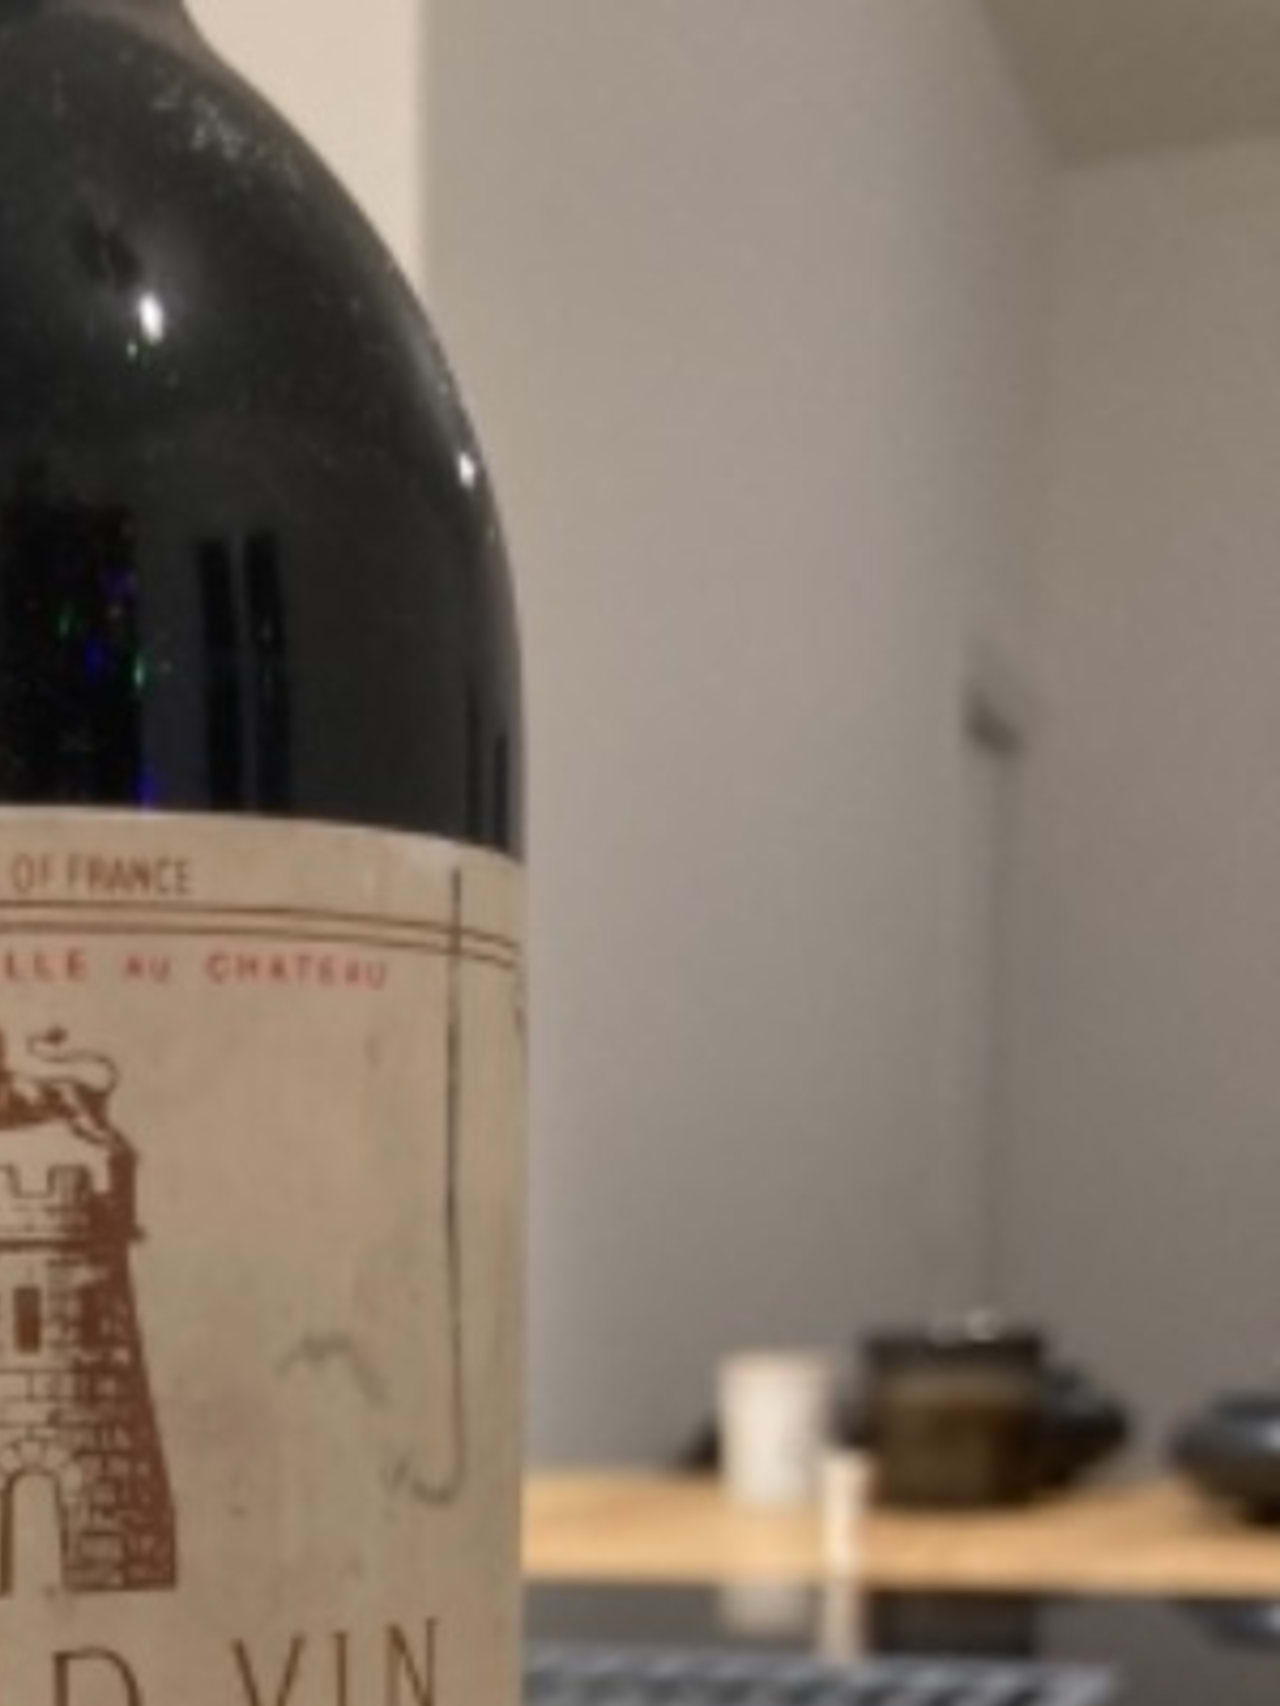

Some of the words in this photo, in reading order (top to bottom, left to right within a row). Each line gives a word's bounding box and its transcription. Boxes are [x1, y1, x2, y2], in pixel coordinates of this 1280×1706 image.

[11, 853, 51, 892] OF
[66, 854, 192, 895] FRANCE
[124, 954, 172, 986] AU
[204, 950, 387, 991] CHATEAU
